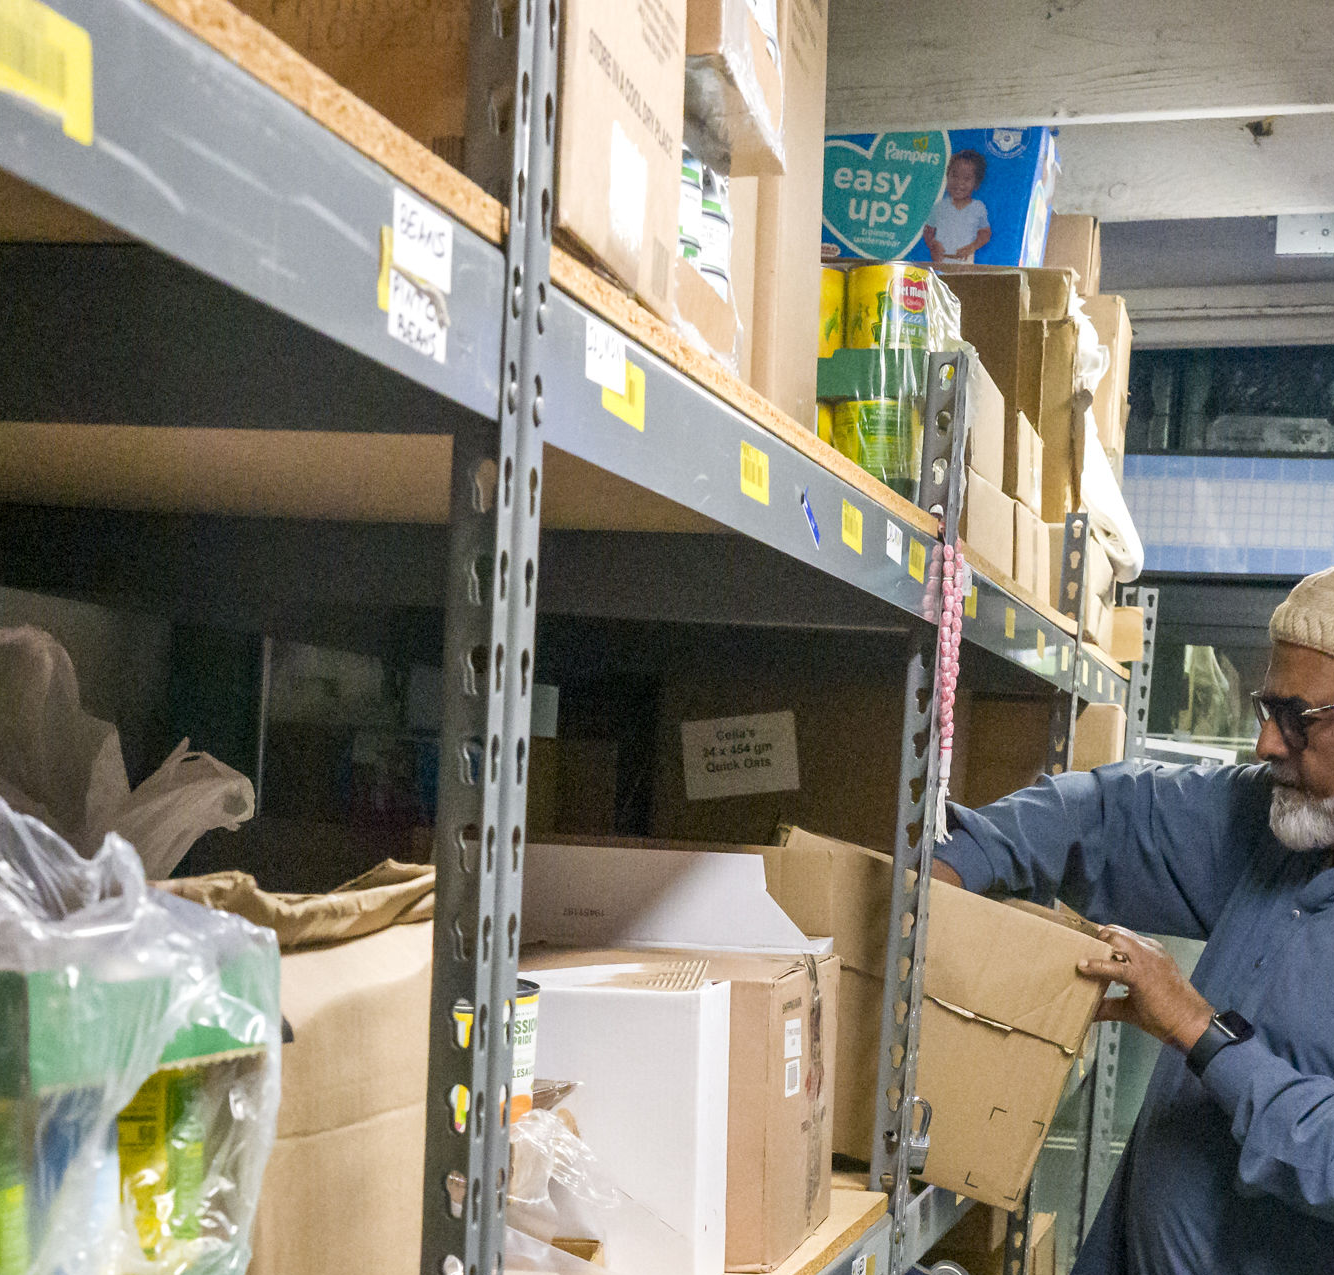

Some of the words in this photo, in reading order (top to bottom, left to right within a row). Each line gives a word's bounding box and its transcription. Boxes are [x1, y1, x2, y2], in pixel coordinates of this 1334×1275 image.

[626, 78, 643, 119] COOL
[643, 101, 656, 133] DRY
[885, 140, 940, 166] Pampers
[833, 167, 912, 201] easy
[847, 198, 909, 227] ups
[852, 236, 902, 248] underwear
[860, 228, 896, 241] training
[909, 287, 929, 299] Mon
[890, 326, 917, 337] Sced
[754, 742, 772, 756] gm
[706, 760, 741, 774] Quick
[744, 756, 771, 769] Oats
